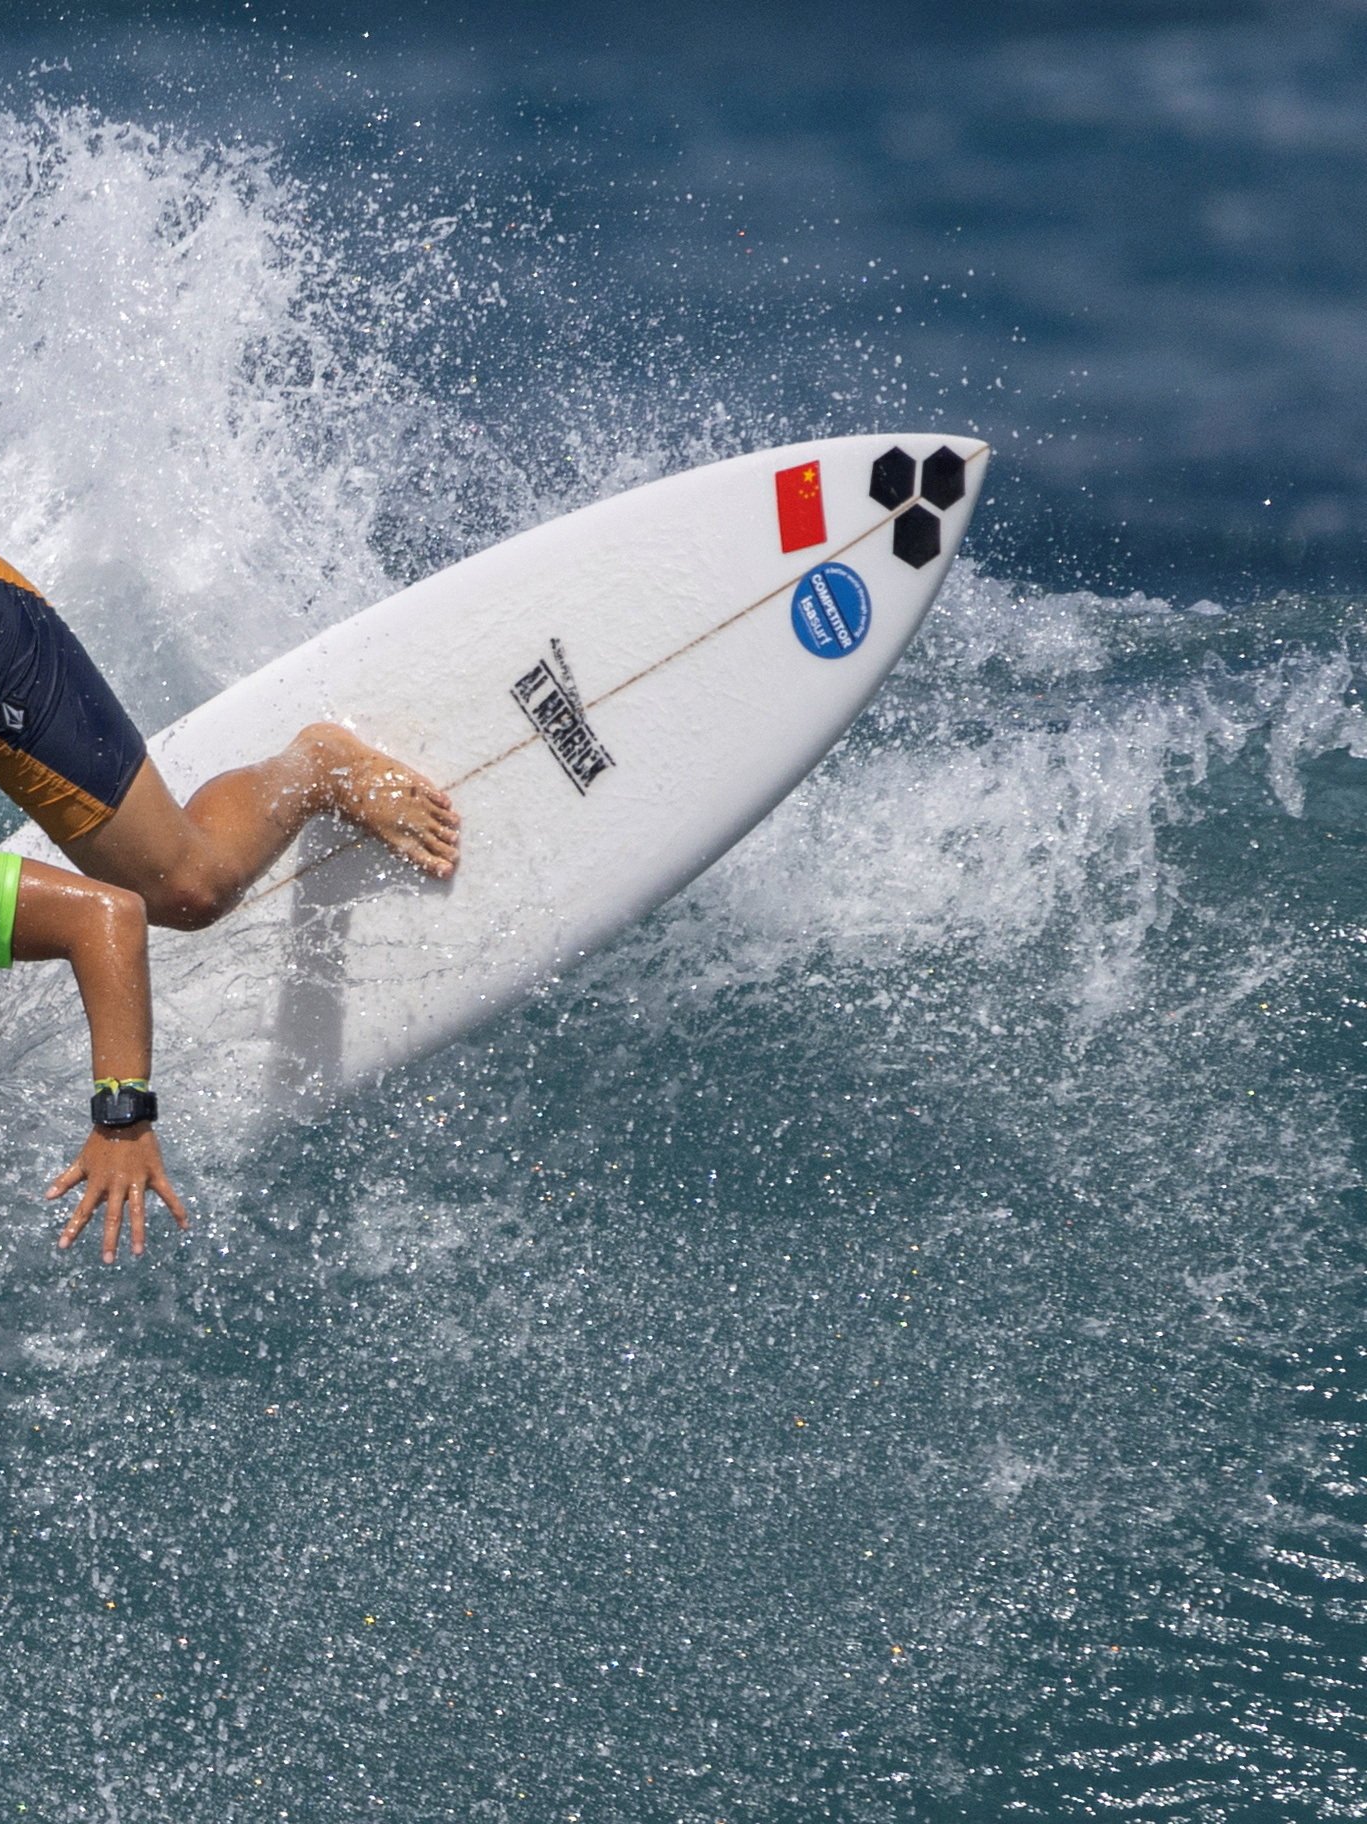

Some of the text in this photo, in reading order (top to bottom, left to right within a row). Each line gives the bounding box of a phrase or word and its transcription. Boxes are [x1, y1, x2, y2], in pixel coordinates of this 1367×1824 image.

[800, 595, 833, 645] isasurf
[812, 574, 852, 648] COMPETITOR
[514, 665, 609, 788] AL MERRICK
